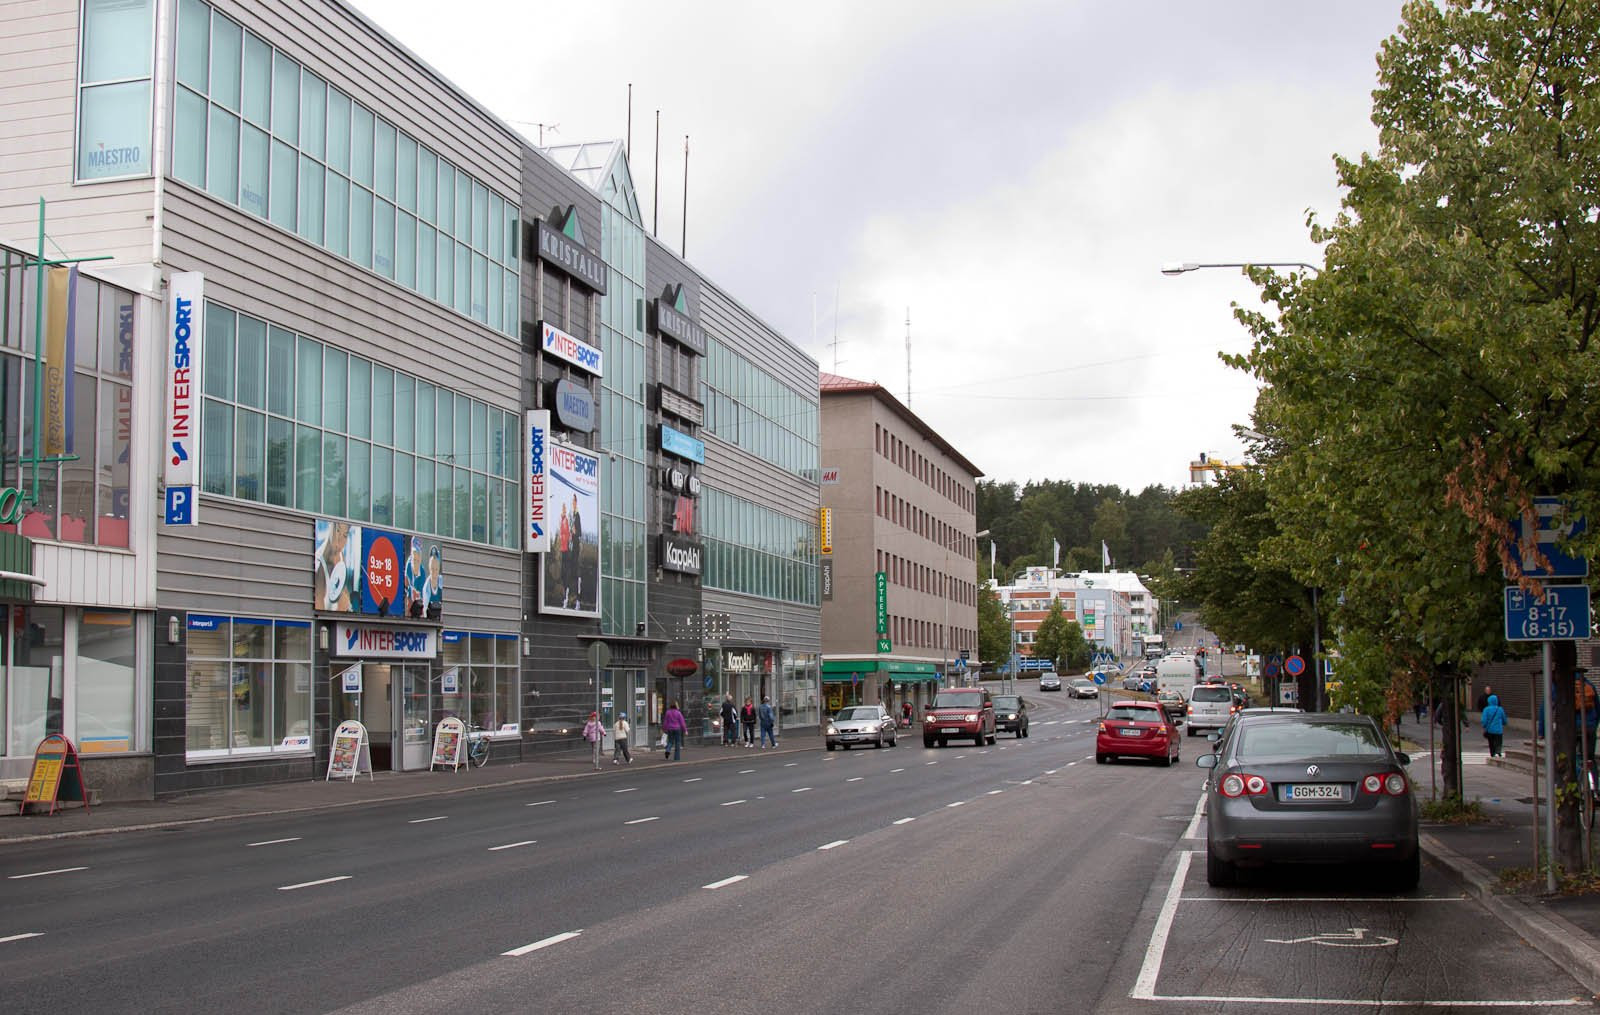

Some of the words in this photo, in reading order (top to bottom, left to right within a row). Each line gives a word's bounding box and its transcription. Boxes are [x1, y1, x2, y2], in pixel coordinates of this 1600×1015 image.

[88, 146, 140, 168] MAESTRO
[541, 228, 604, 287] KRISTALLI
[660, 305, 705, 351] KRISTALLI
[555, 332, 600, 370] INTERSPORT
[172, 297, 192, 438] INTERSPORT
[563, 391, 589, 418] MAESTRO
[532, 426, 543, 520] INTERSPORT
[552, 447, 597, 478] INTERSPORT
[172, 491, 185, 511] P
[385, 557, 392, 571] 18
[666, 541, 700, 571] KappAhl
[360, 628, 428, 653] INTERSPORT
[1521, 619, 1575, 637] (8-15)
[728, 651, 752, 673] KappAhl
[1294, 786, 1340, 797] GGM-324
